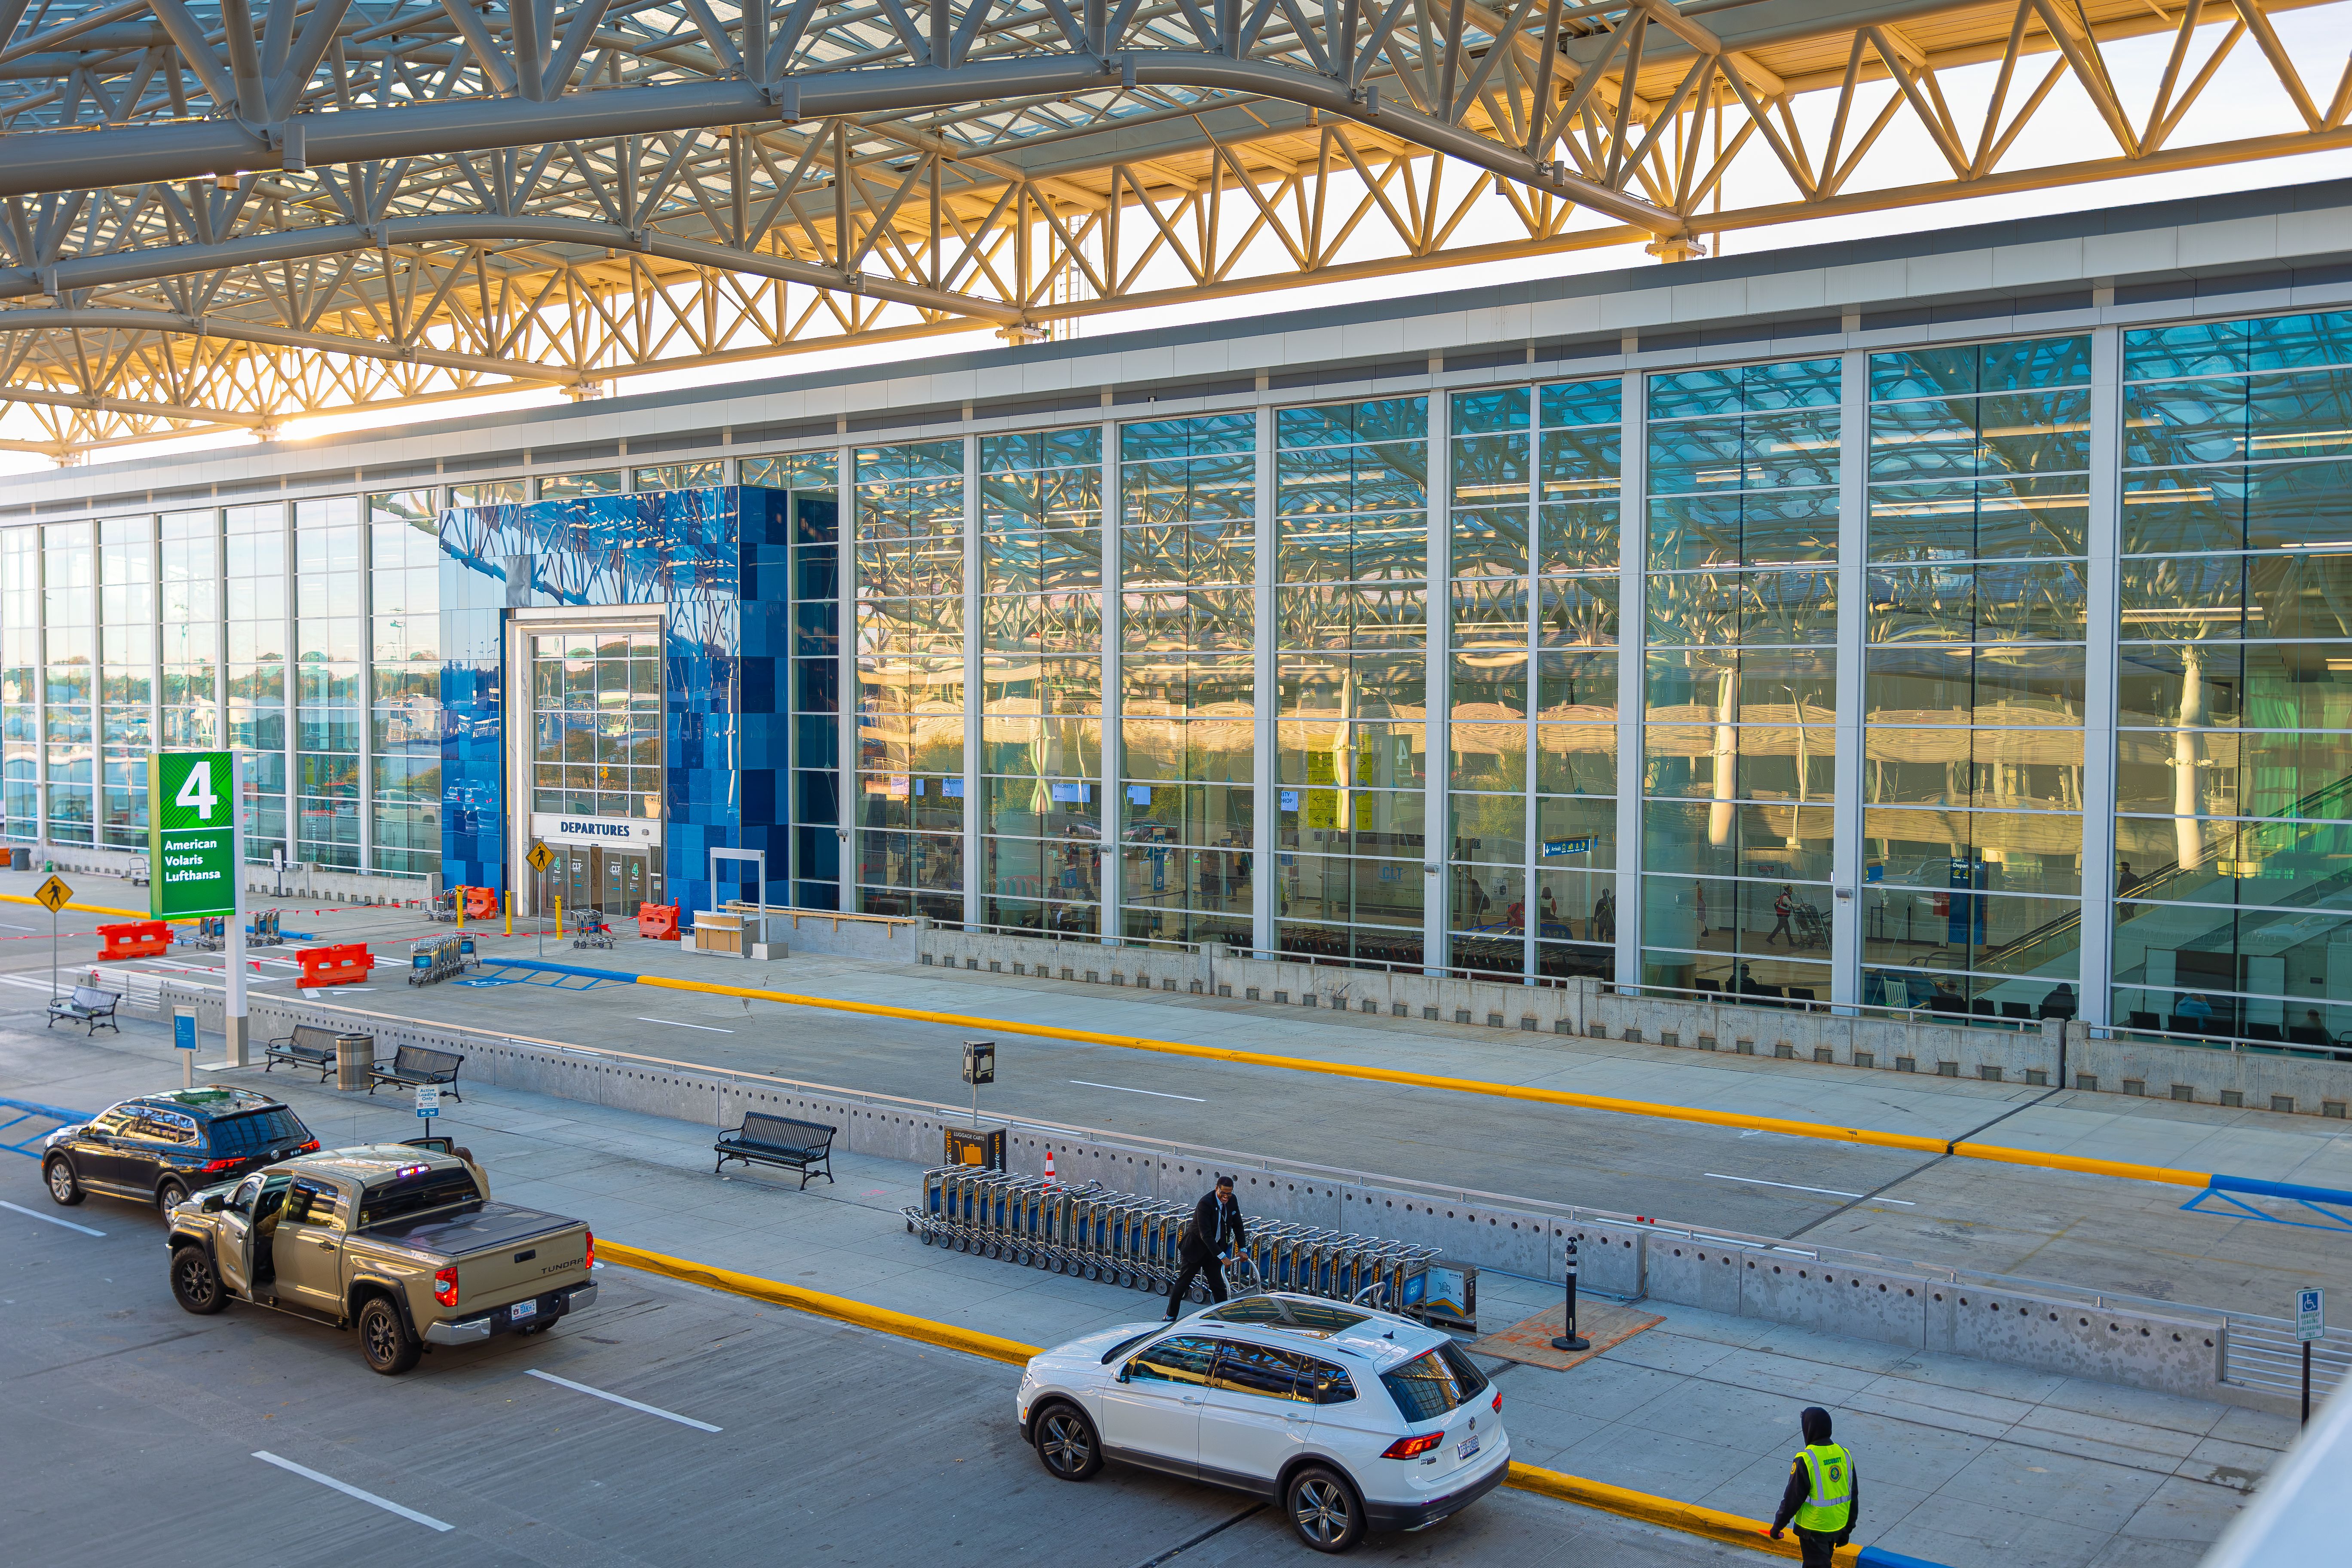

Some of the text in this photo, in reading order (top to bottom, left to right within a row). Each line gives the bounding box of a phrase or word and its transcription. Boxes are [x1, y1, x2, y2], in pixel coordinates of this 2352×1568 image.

[176, 761, 218, 819] 4
[561, 821, 630, 837] DEPARTURES
[165, 839, 217, 851] American
[165, 854, 203, 866] Volaris
[554, 857, 560, 870] 4
[572, 862, 582, 870] CLT
[631, 863, 639, 876] 4
[1382, 867, 1403, 880] CLT
[166, 870, 221, 882] Lufthansa
[541, 1257, 584, 1274] TUNDRA
[1409, 1285, 1419, 1294] CLT
[2300, 1311, 2320, 1320] HANDICAP
[1823, 1457, 1841, 1466] SECURITY
